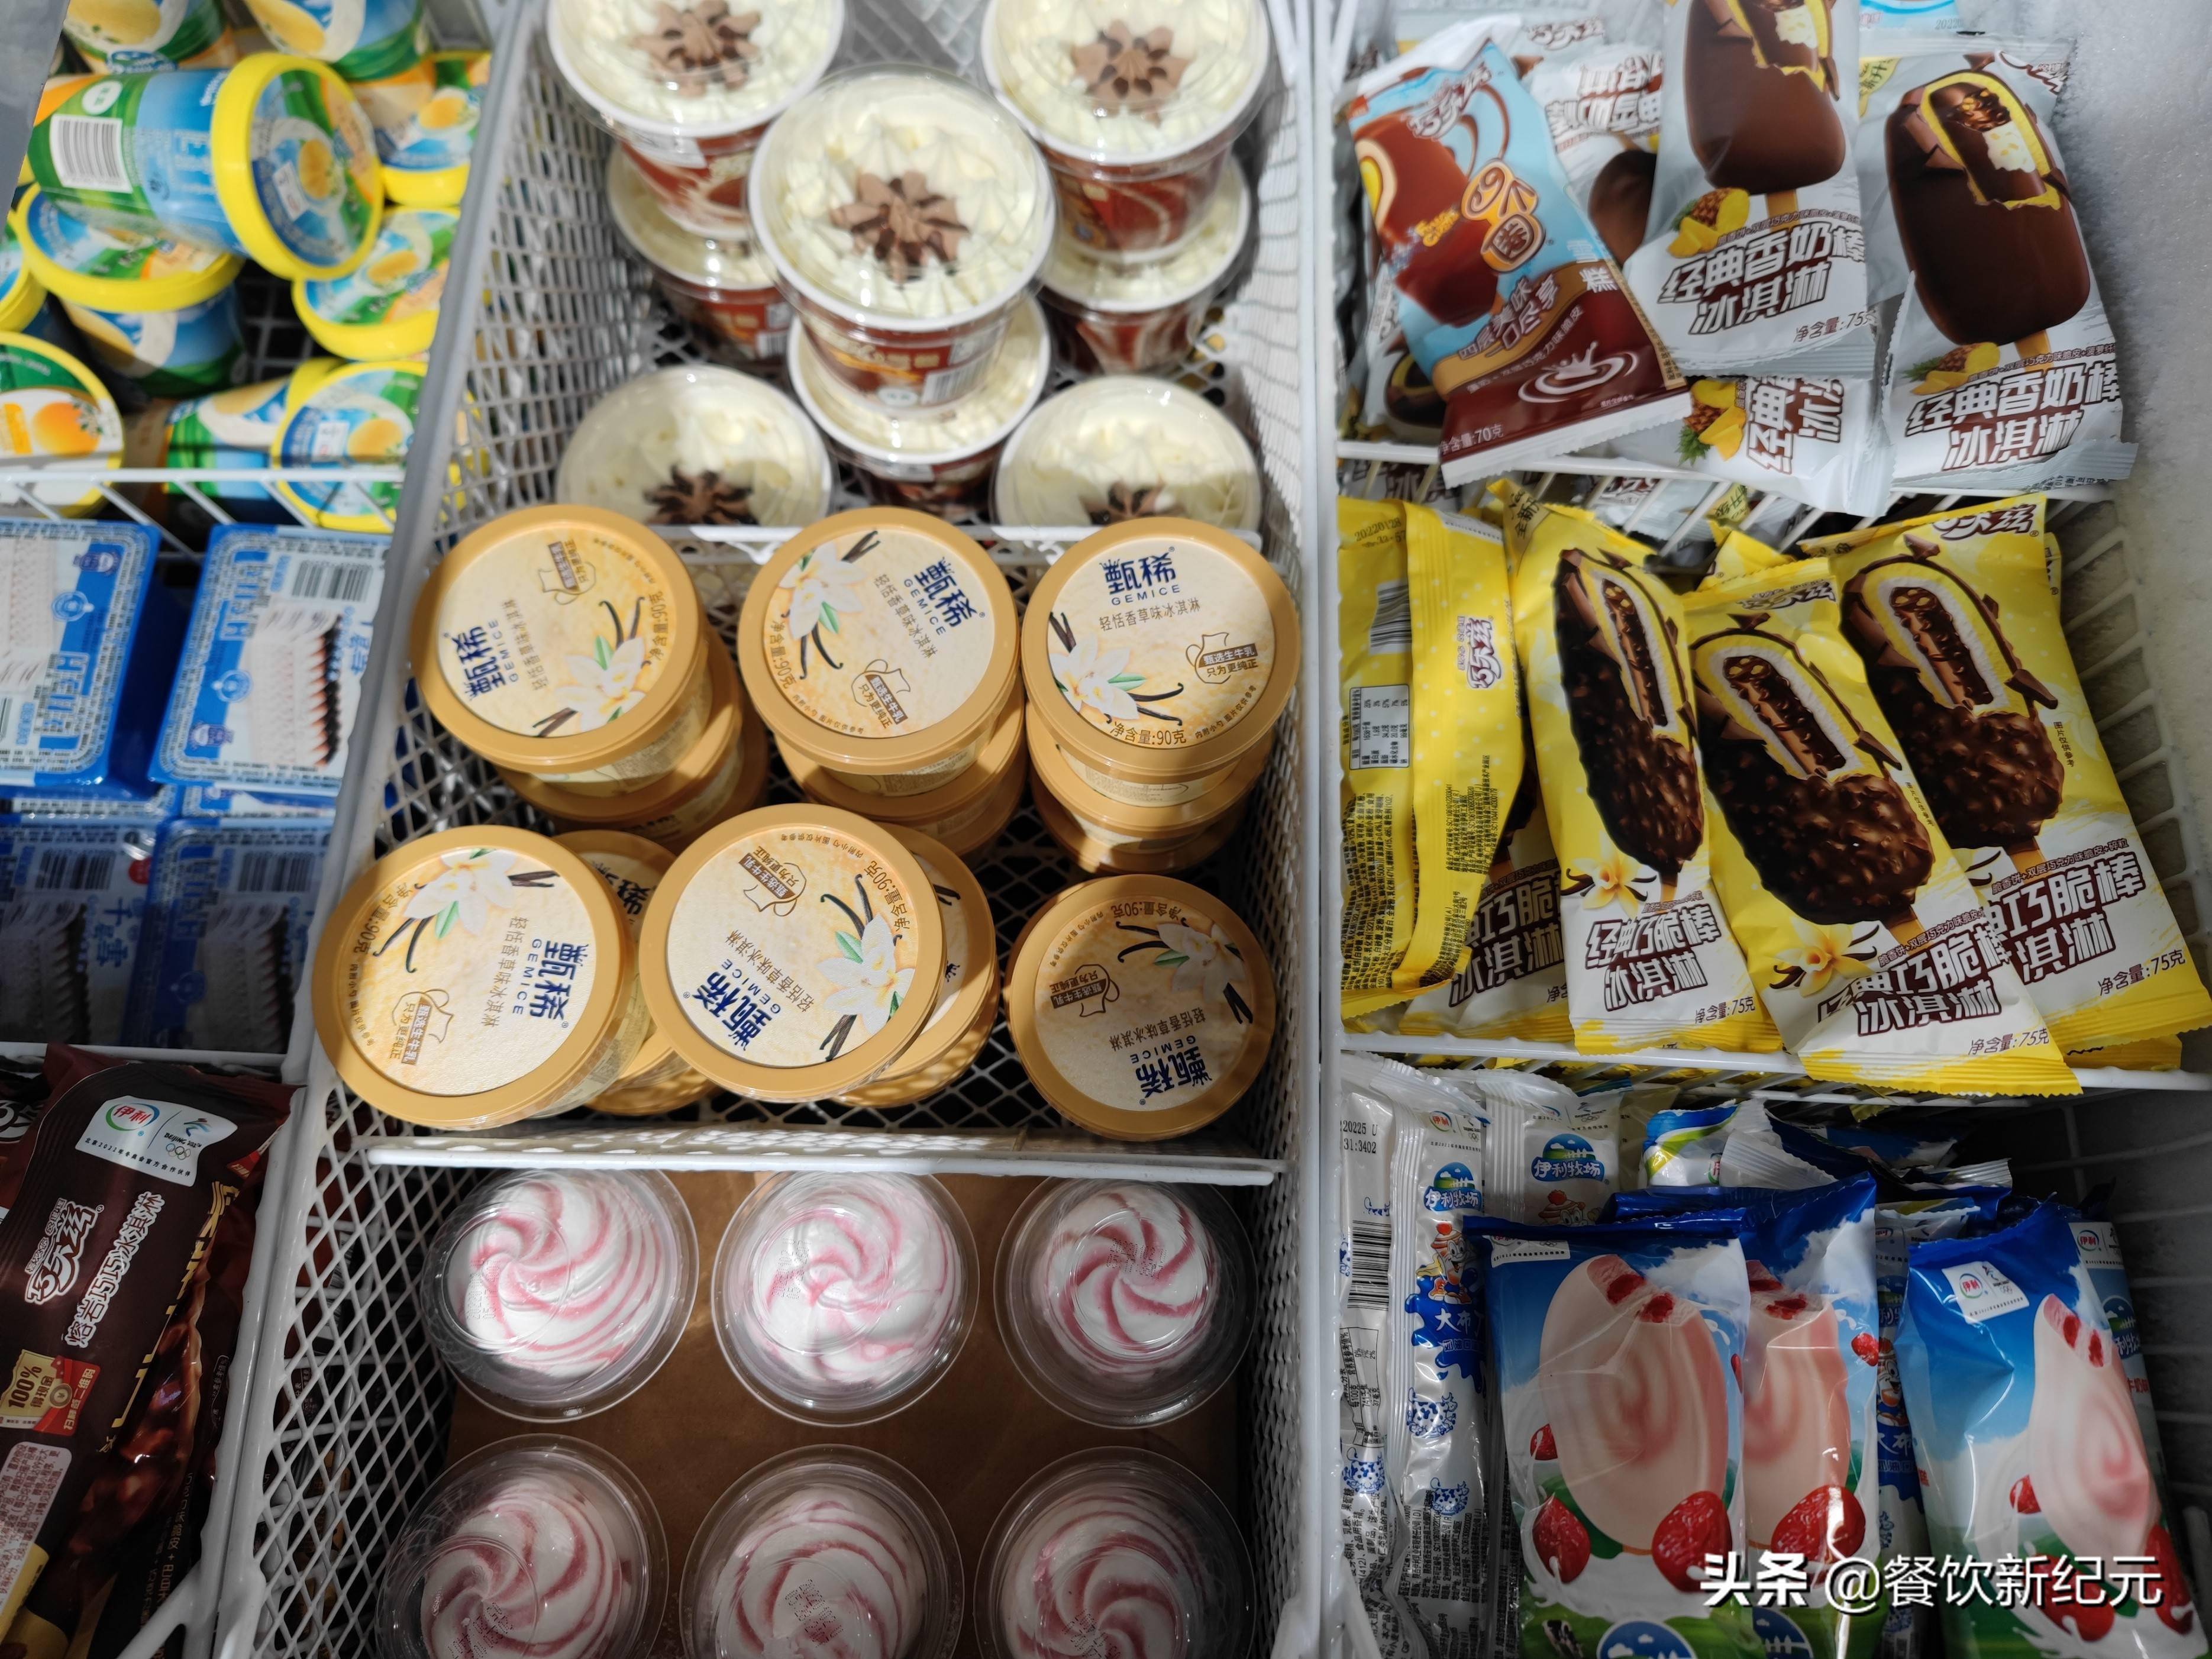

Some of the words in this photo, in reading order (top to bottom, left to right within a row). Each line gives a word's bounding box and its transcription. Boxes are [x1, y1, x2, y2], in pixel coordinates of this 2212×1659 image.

[1565, 239, 1619, 293] 雪糕
[1657, 221, 1865, 304] 经典香奶棒
[1458, 275, 1533, 360] 四层美味
[1688, 261, 1832, 335] 冰淇淋
[1905, 359, 2122, 438] 经典香奶棒
[1942, 409, 2085, 472] 冰淇淋
[1354, 517, 1403, 543] 20220128
[914, 556, 979, 628] 甄稀
[1099, 551, 1176, 596] 甄稀
[1110, 583, 1180, 606] GEMICE
[873, 573, 938, 660] 轻恬香草味冰淇淋
[903, 578, 945, 635] GEMICE
[1099, 597, 1201, 632] 轻恬香草味冰淇淋
[451, 624, 507, 702] 甄稀
[488, 619, 519, 683] GEMICE
[1466, 615, 1503, 690] 巧乐兹
[1110, 721, 1187, 746] 净含量:90克
[2053, 721, 2075, 768] 图片仅供参考
[1991, 838, 2130, 896] 脆香饼+双层巧克力味脆皮+碎粒
[864, 858, 910, 933] 净含量:90克
[1584, 902, 1722, 970] 经典巧脆棒
[512, 938, 542, 1016] GEMICE
[529, 940, 589, 1022] 甄稀
[721, 958, 782, 1015] GEMICE
[725, 929, 815, 1014] 轻恬香草味冰淇淋
[1603, 949, 1709, 1012] 冰淇淋
[2097, 948, 2187, 996] 净含量:75克
[692, 971, 773, 1051] 甄稀
[1109, 1006, 1207, 1052] 轻恬香草味冰淇淋
[1694, 996, 1756, 1025] 净含量:75克
[1855, 974, 2003, 1037] 冰淇淋
[1129, 1035, 1196, 1064] GEMICE
[1967, 1026, 2050, 1057] 净含量:75克
[1135, 1045, 1213, 1099] 甄稀
[114, 1105, 149, 1125] 伊利
[1340, 1120, 1366, 1135] 20225
[1533, 1158, 1601, 1178] 伊利牧场
[1425, 1187, 1480, 1209] 伊利牧场
[26, 1200, 97, 1304] 巧乐兹
[2079, 1236, 2096, 1247] 伊利
[66, 1192, 166, 1348] 熔岩巧巧冰淇淋
[1962, 1279, 1980, 1290] 伊利
[1354, 1348, 1361, 1358] 9%
[1369, 1350, 1376, 1360] 2%
[8, 1364, 43, 1409] 100%
[1348, 1384, 1360, 1408] 每100克
